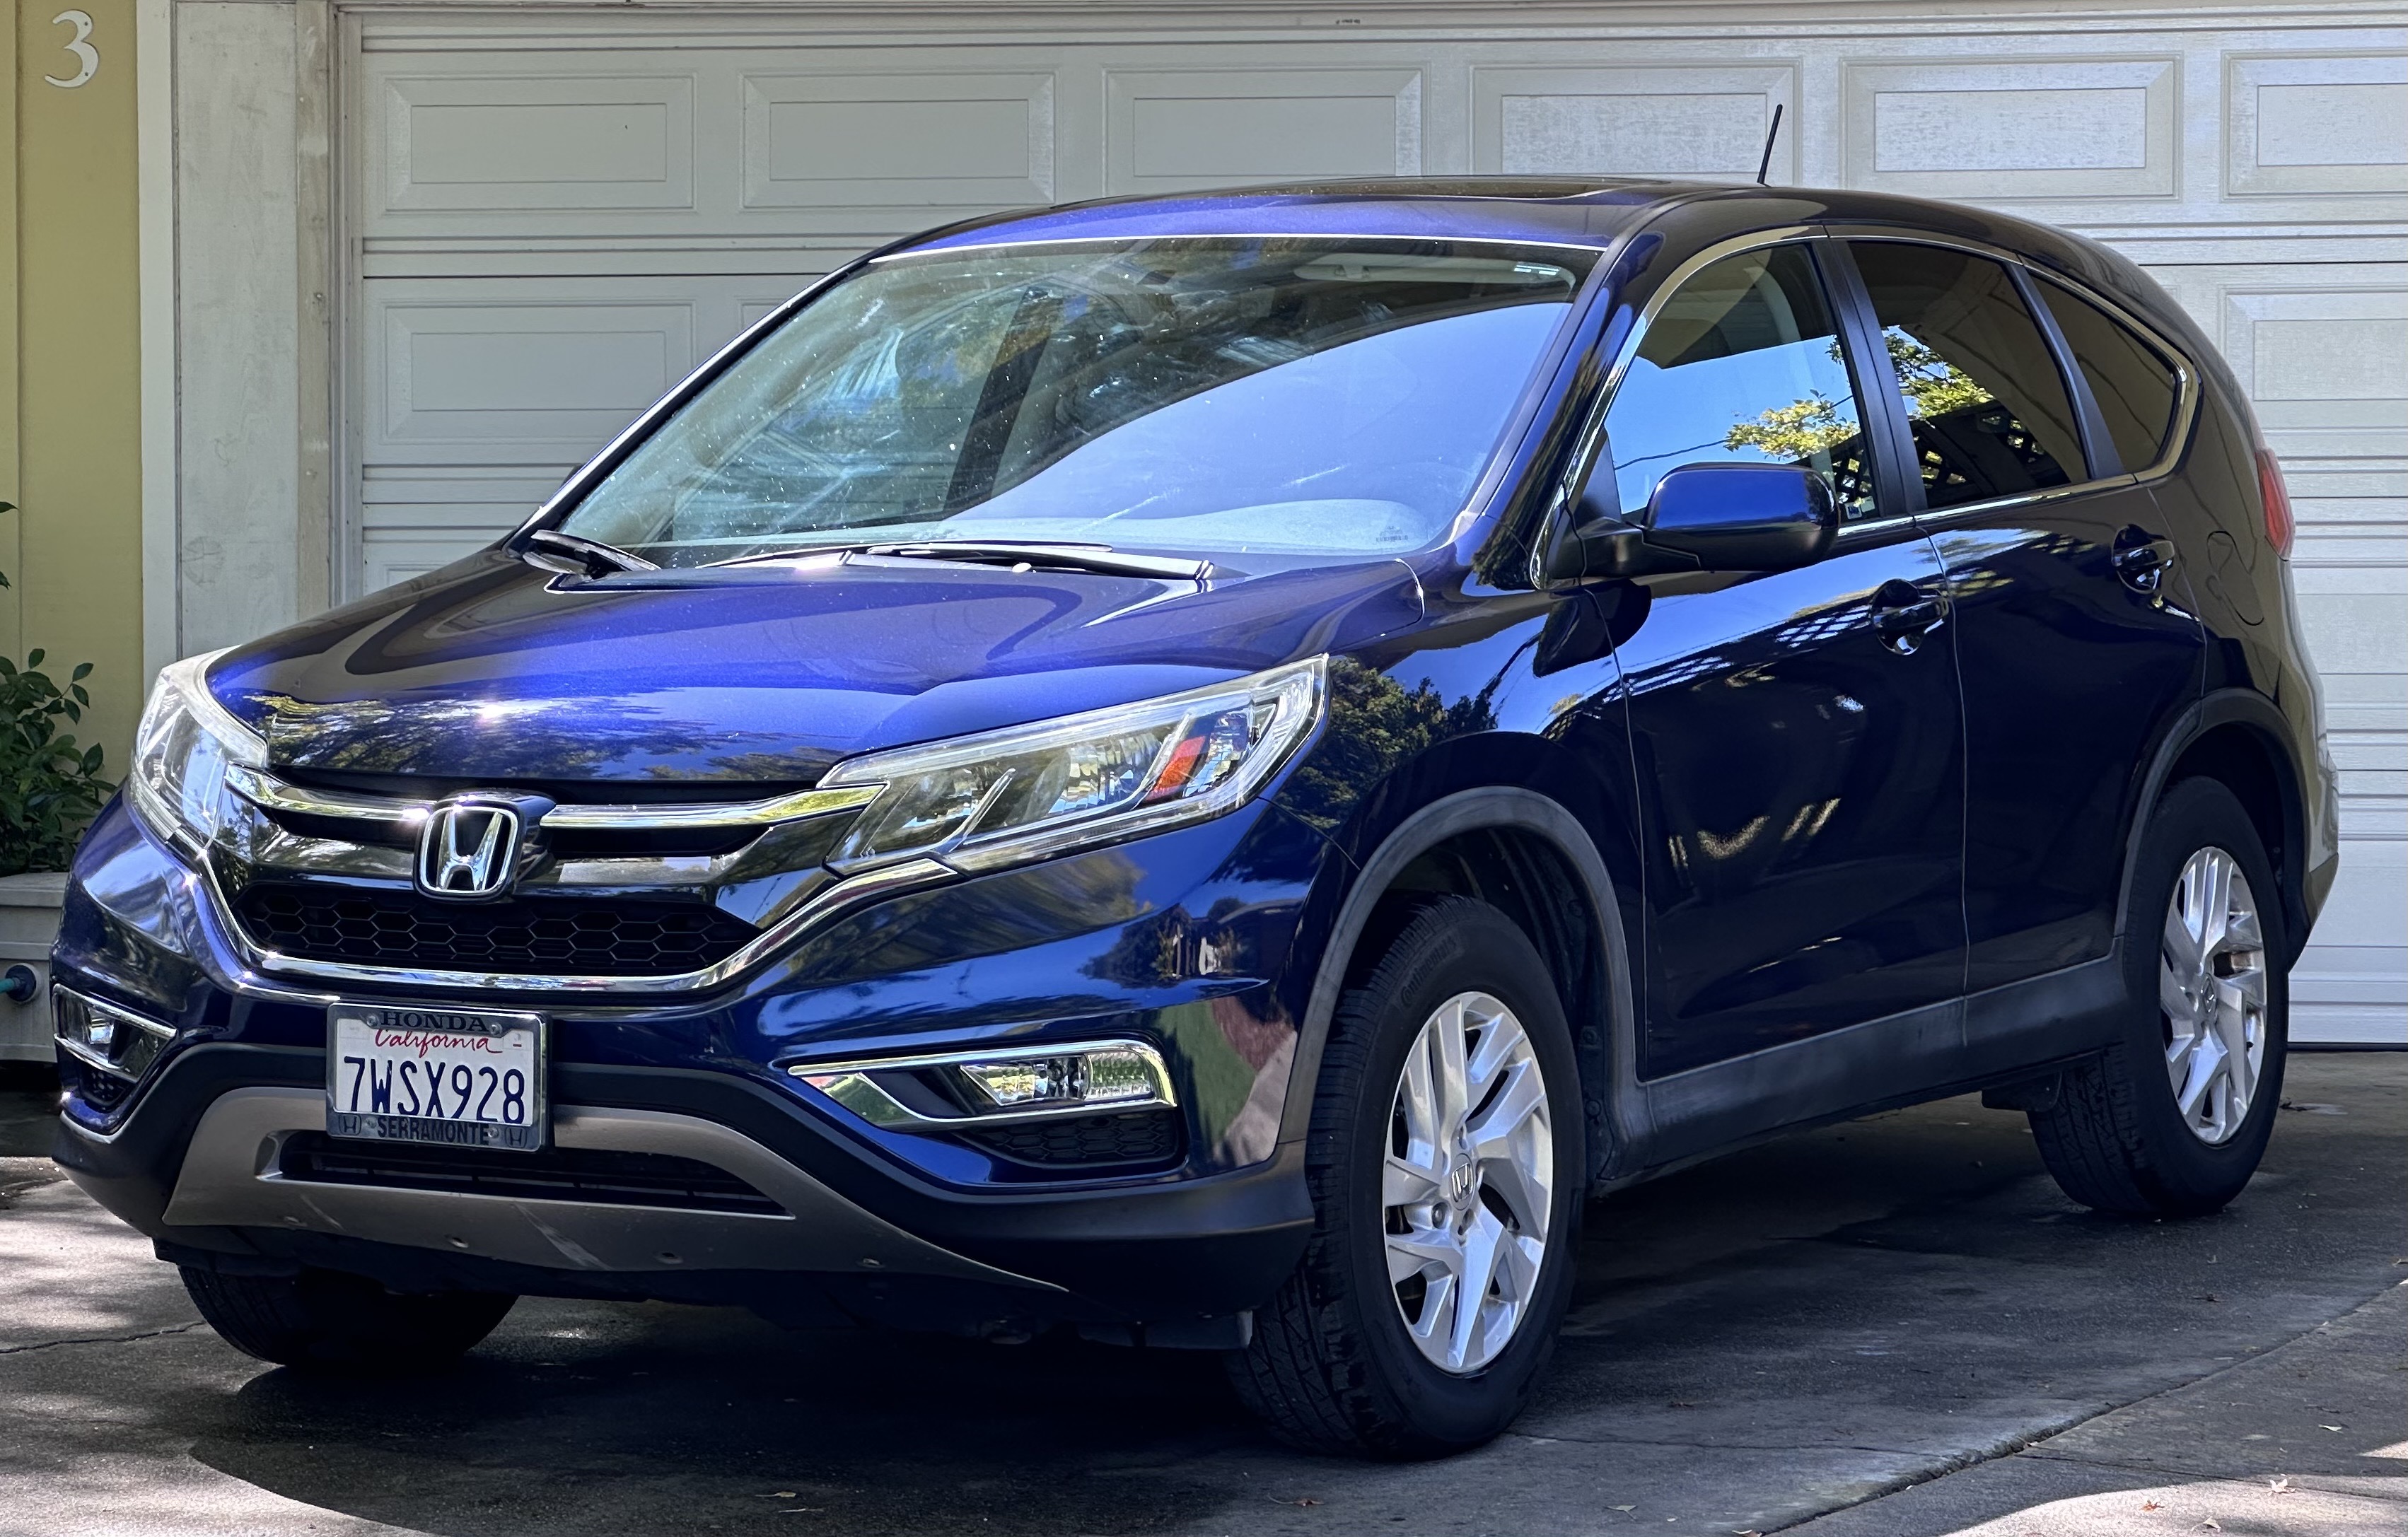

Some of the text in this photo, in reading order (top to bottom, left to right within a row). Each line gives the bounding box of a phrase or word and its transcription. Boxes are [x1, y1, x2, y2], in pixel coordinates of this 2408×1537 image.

[45, 9, 100, 88] 3
[380, 1011, 489, 1032] HONDA
[375, 1029, 503, 1058] California
[344, 1056, 525, 1124] 7WSX928
[377, 1116, 489, 1145] SERRAMONTE
